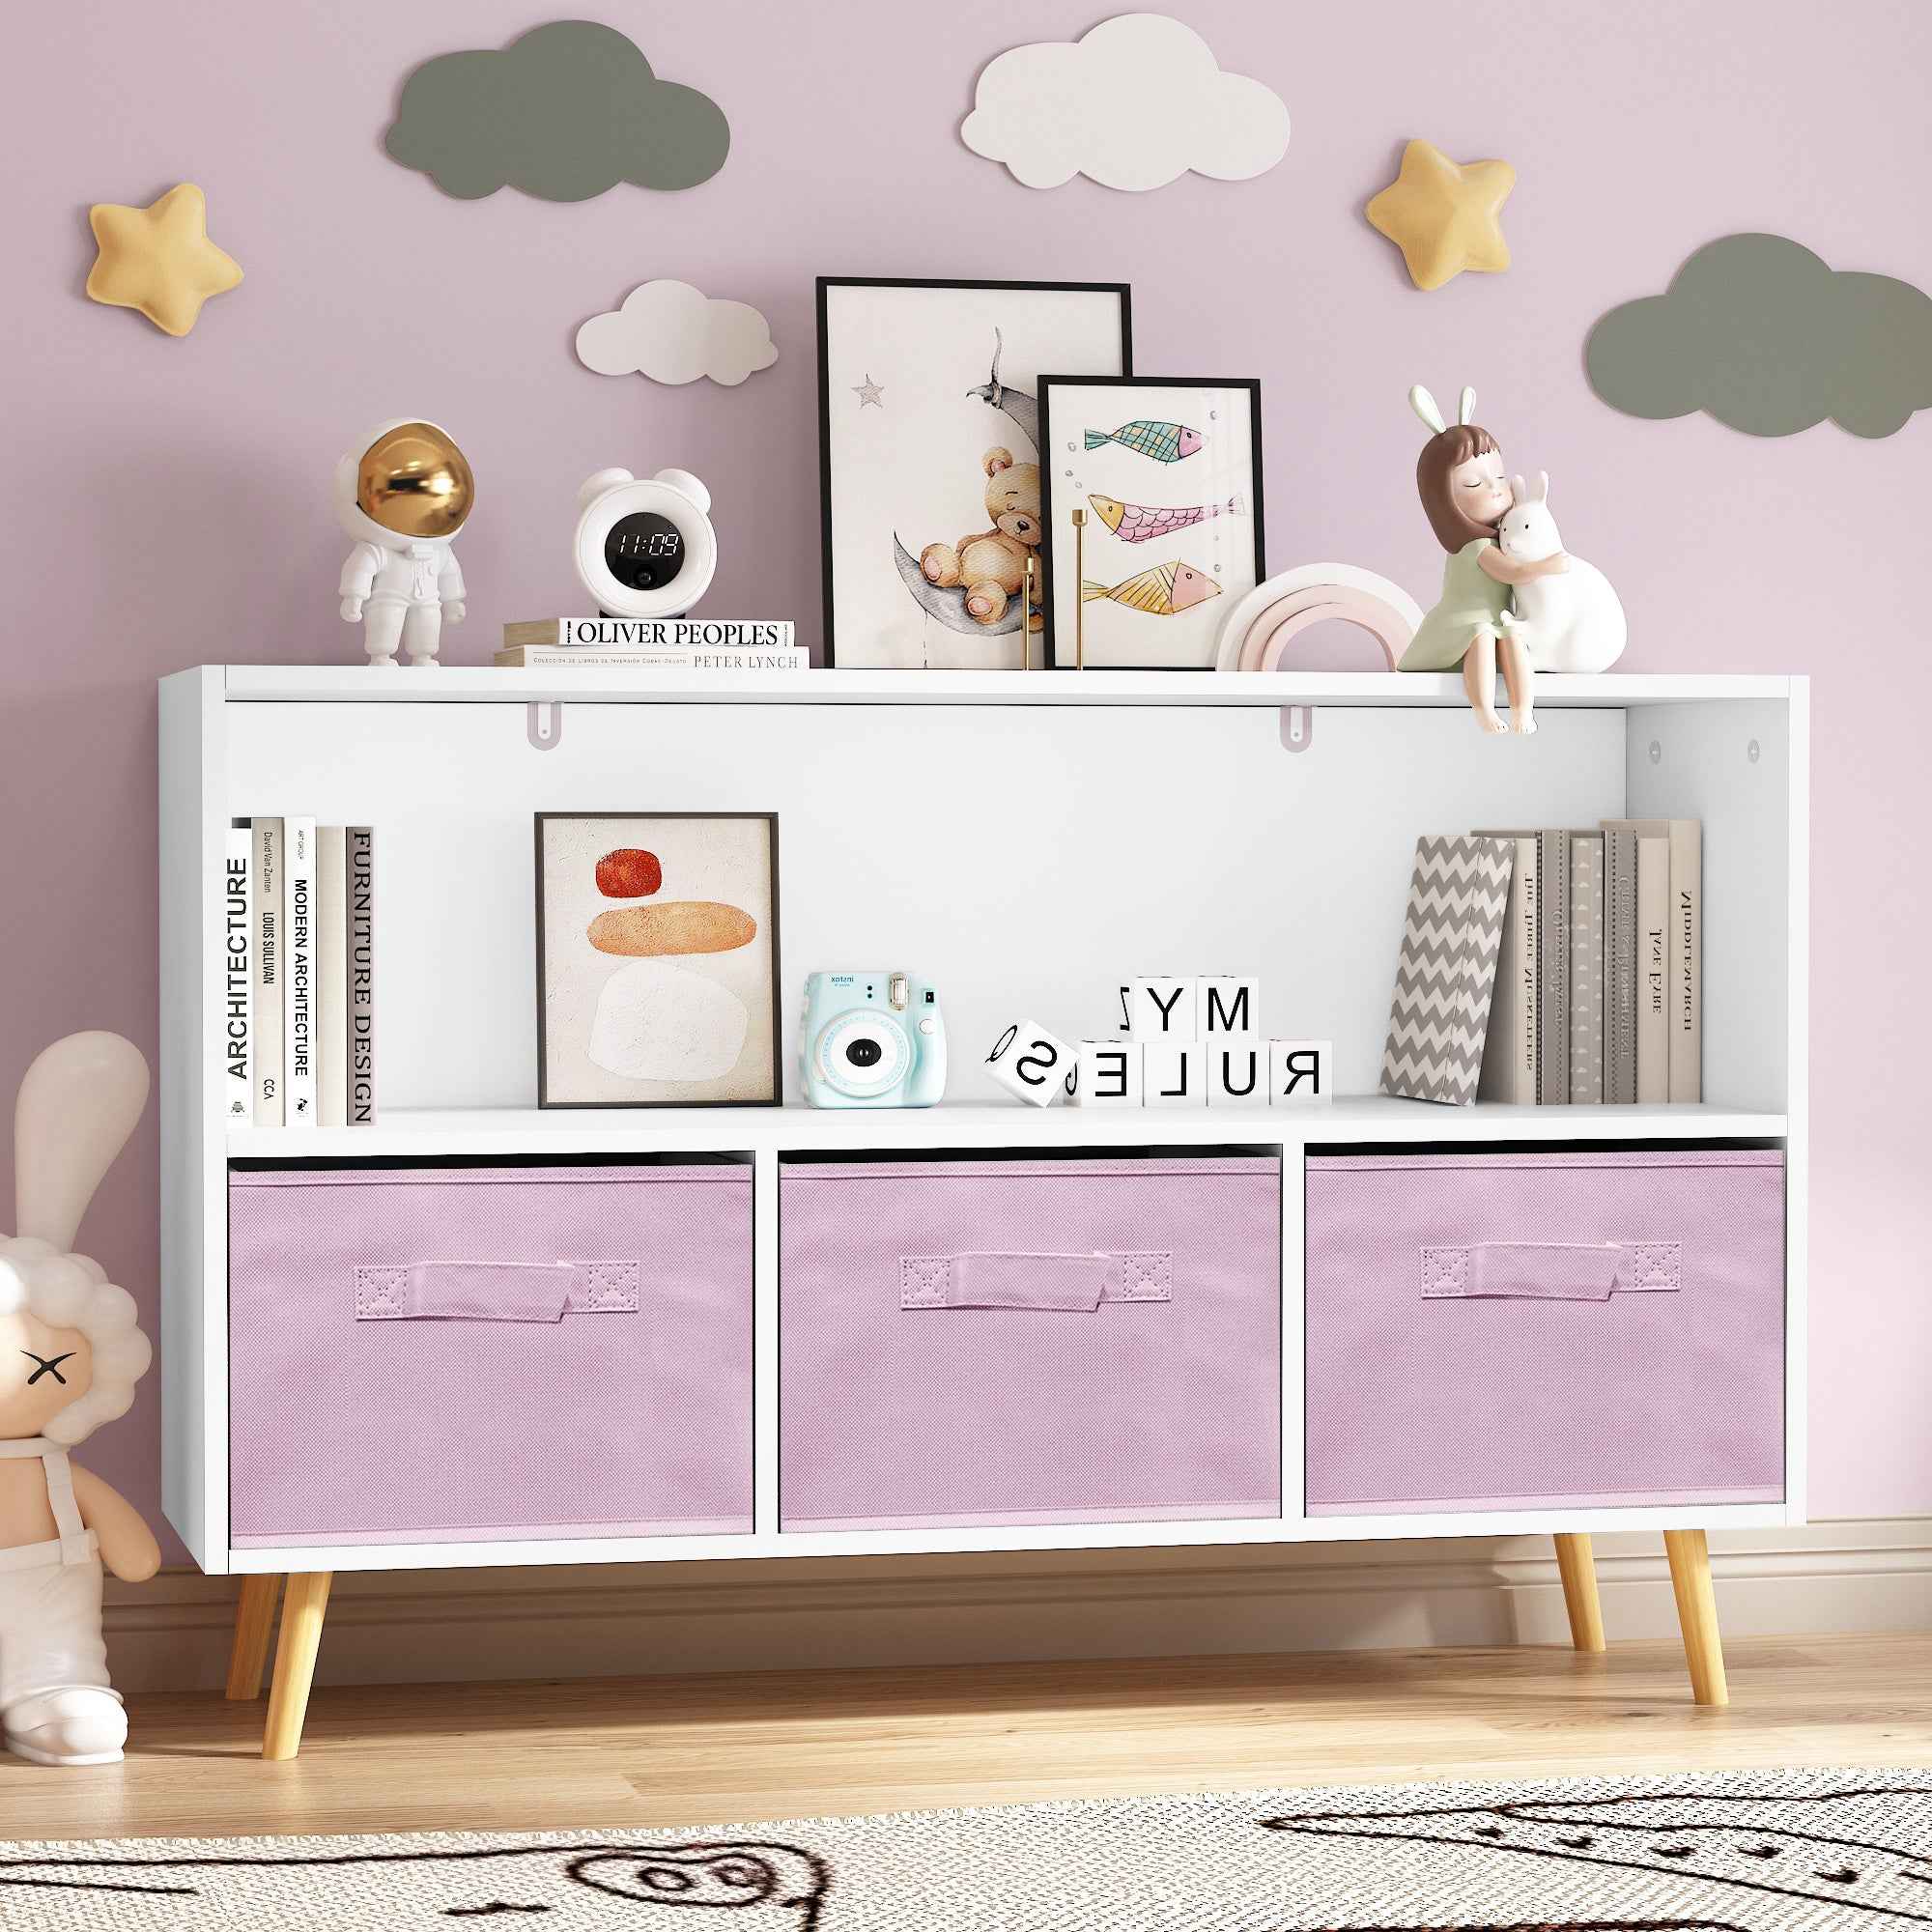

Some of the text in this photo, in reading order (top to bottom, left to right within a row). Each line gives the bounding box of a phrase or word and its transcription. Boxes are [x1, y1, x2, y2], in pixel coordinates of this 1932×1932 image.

[619, 533, 679, 556] 11:09
[577, 621, 667, 644] OLIVER
[673, 622, 779, 645] PEOPLES
[694, 655, 798, 668] PETER LYNCH
[264, 832, 273, 853] David
[226, 858, 247, 1080] ARCHITECTURE
[263, 912, 274, 984] LOUIS SULLIVAN
[295, 879, 308, 1076] MODERN ARCHITECTURE
[354, 832, 371, 1123] FURNITURE DESIGN
